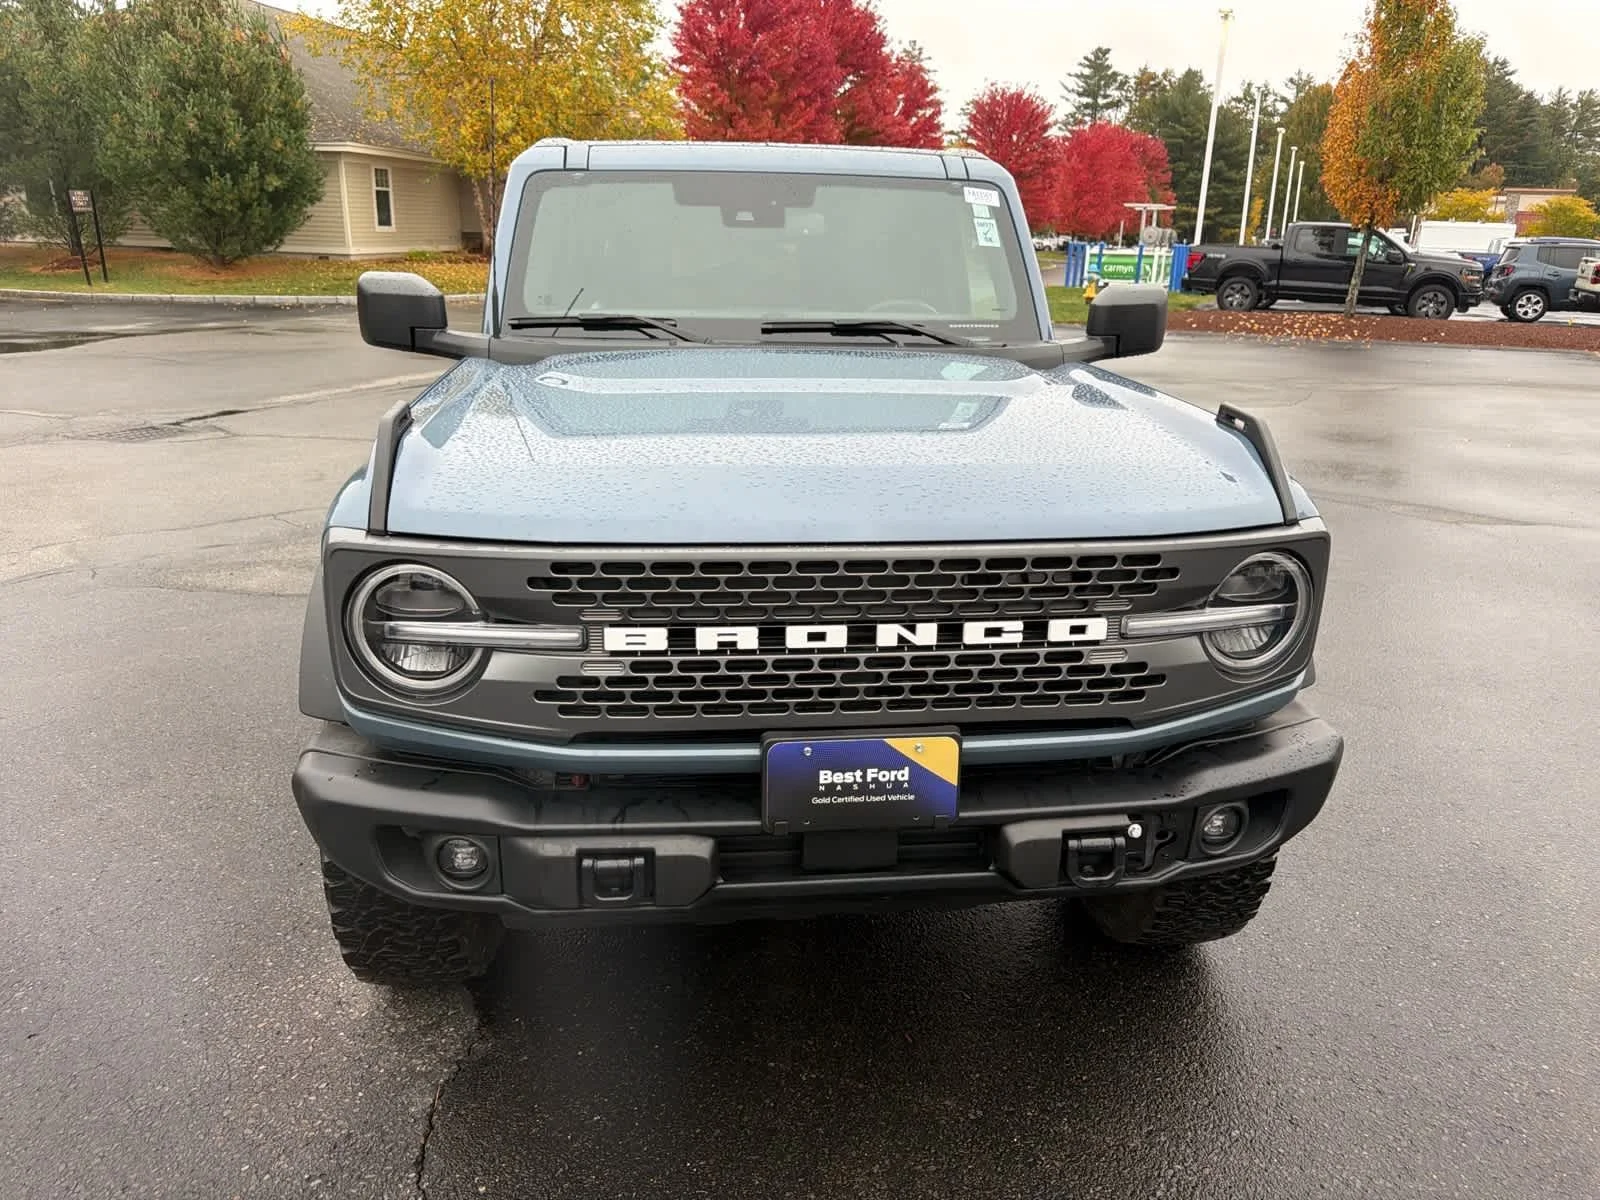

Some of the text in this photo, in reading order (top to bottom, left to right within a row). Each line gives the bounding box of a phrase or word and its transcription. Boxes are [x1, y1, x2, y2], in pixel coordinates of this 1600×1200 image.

[1103, 263, 1135, 273] carmyn
[604, 618, 1108, 651] BRONCO
[819, 767, 910, 784] Best Ford
[818, 782, 909, 791] NASHUA
[811, 796, 831, 804] Gold
[831, 795, 864, 803] Certified
[887, 793, 915, 801] Vehicle
